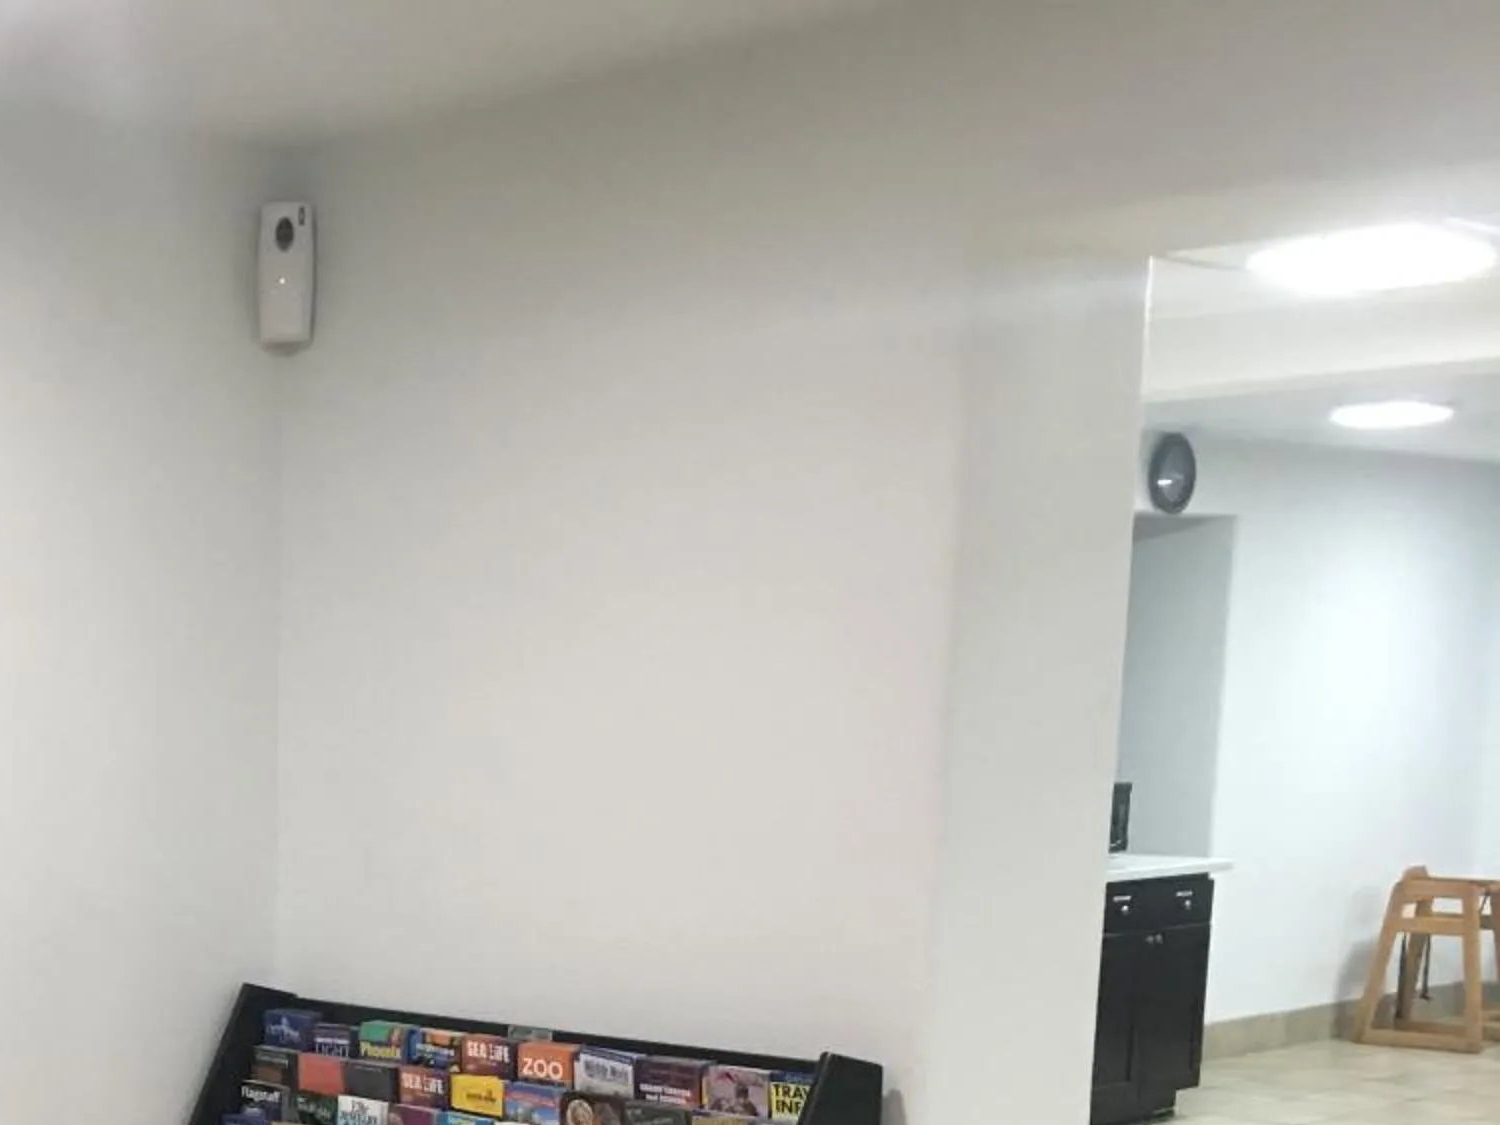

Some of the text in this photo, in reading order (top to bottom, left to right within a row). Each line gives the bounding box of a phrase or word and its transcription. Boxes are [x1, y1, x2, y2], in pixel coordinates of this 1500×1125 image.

[467, 1040, 487, 1058] SEA
[522, 1057, 564, 1080] ZOO
[401, 1072, 422, 1089] SEA
[772, 1083, 809, 1099] TRAV
[775, 1100, 802, 1114] INF
